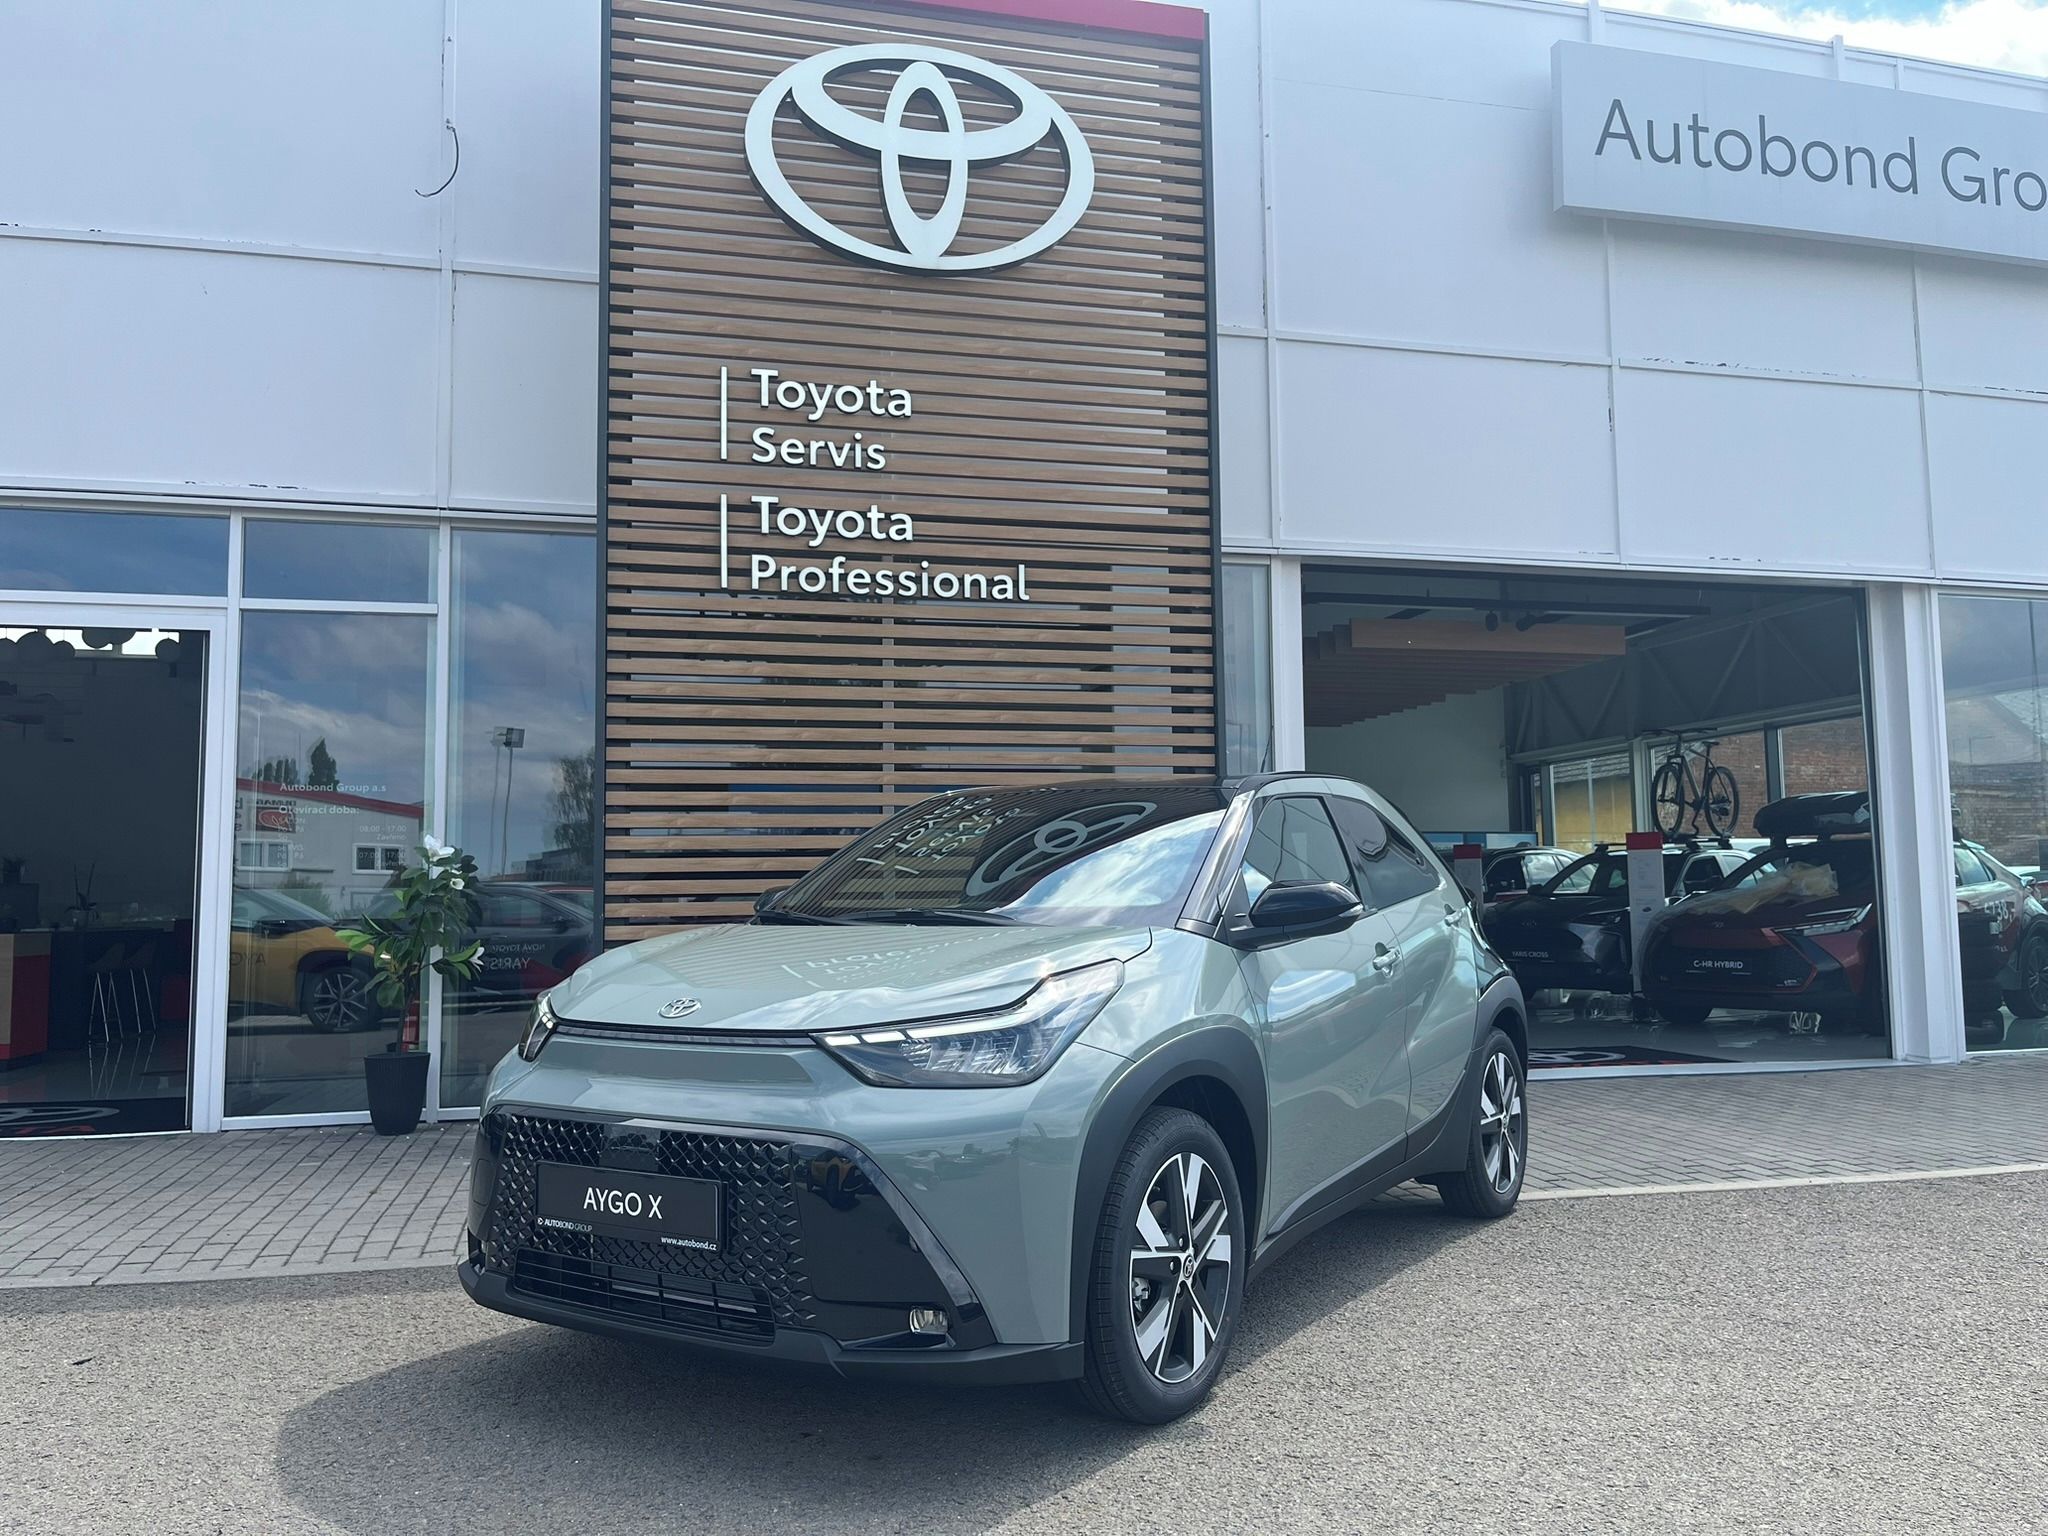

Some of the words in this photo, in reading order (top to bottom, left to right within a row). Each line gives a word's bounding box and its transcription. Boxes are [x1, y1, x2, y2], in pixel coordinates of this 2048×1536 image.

[1594, 98, 1919, 196] Autobond
[1941, 146, 2047, 212] Gro
[751, 368, 912, 421] Toyota
[752, 427, 886, 470] Servis
[751, 495, 914, 547] Toyota
[751, 554, 1030, 601] Professional
[279, 783, 334, 792] Autobond
[336, 783, 370, 795] Group
[329, 805, 360, 814] doba:
[1693, 960, 1713, 968] C-HR
[1714, 961, 1744, 969] HYBRID
[583, 1187, 642, 1217] AYGO
[648, 1194, 663, 1219] X
[544, 1218, 575, 1230] AUTOBOND
[575, 1223, 593, 1232] GROUP
[661, 1236, 717, 1251] www.autobond.cz
